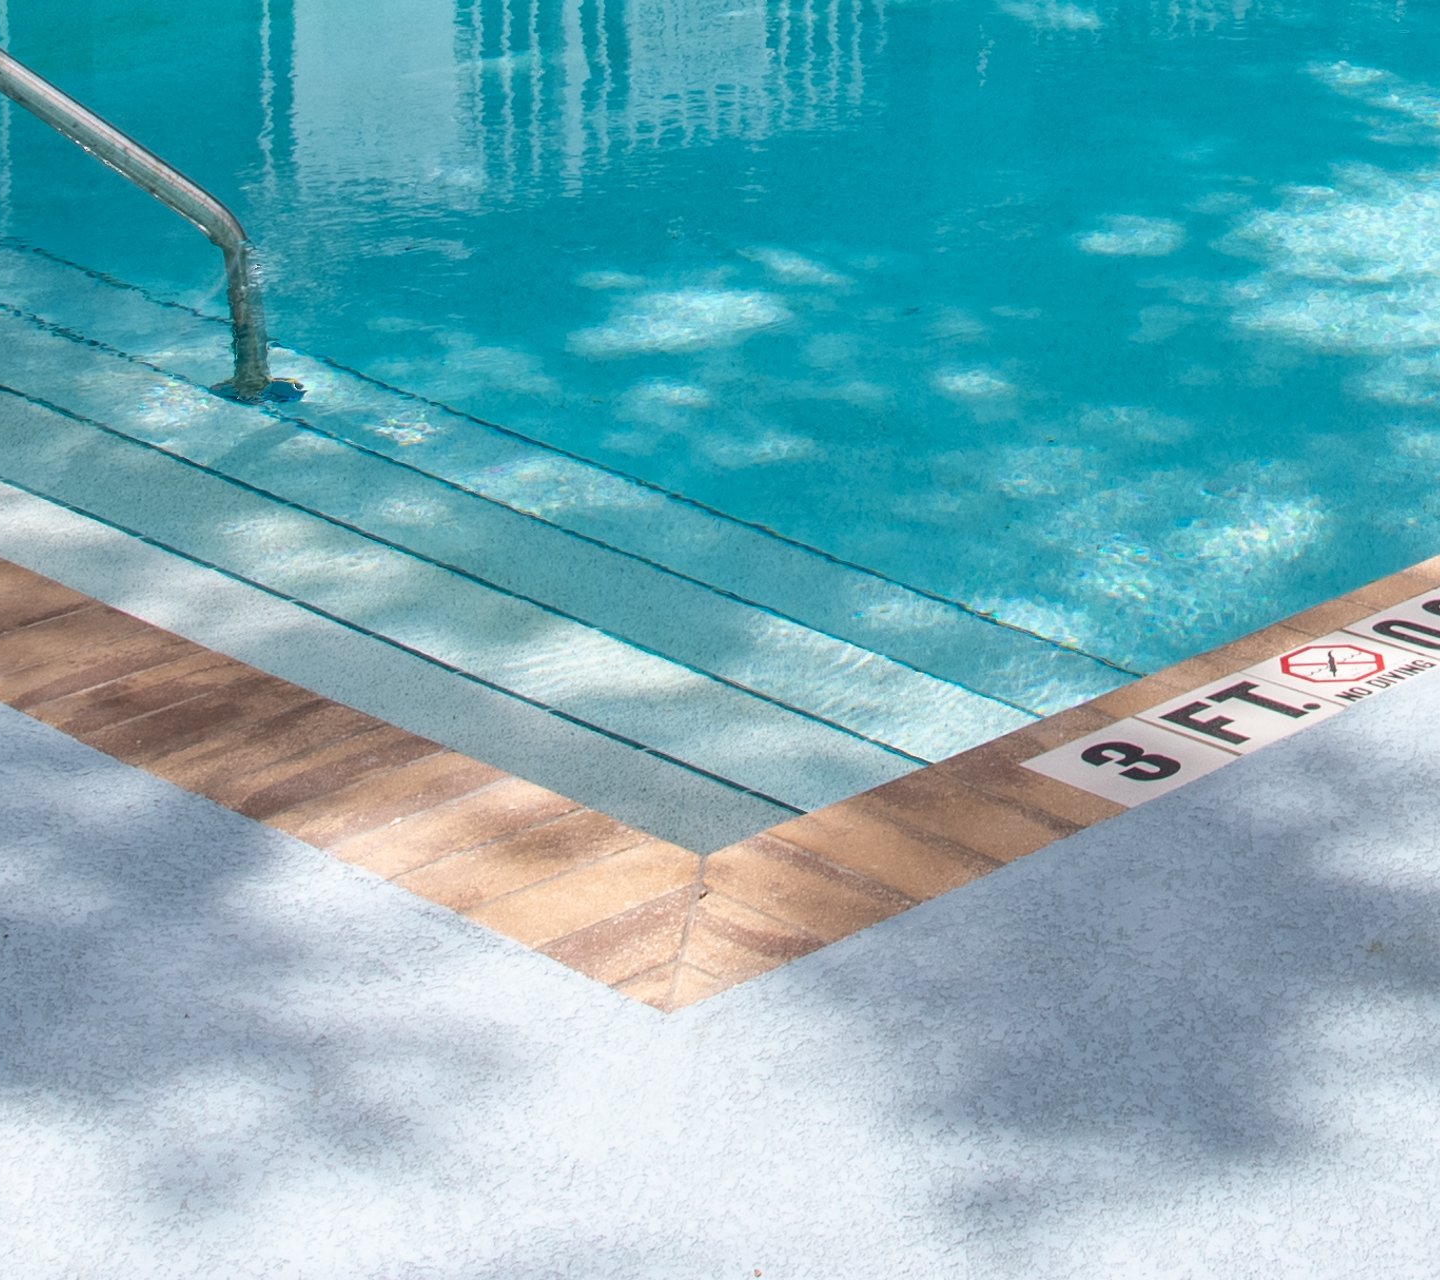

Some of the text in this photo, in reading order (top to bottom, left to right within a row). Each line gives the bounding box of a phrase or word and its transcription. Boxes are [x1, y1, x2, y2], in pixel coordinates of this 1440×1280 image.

[1335, 659, 1437, 702] NO DIVING
[1081, 680, 1322, 782] 3 FT.
